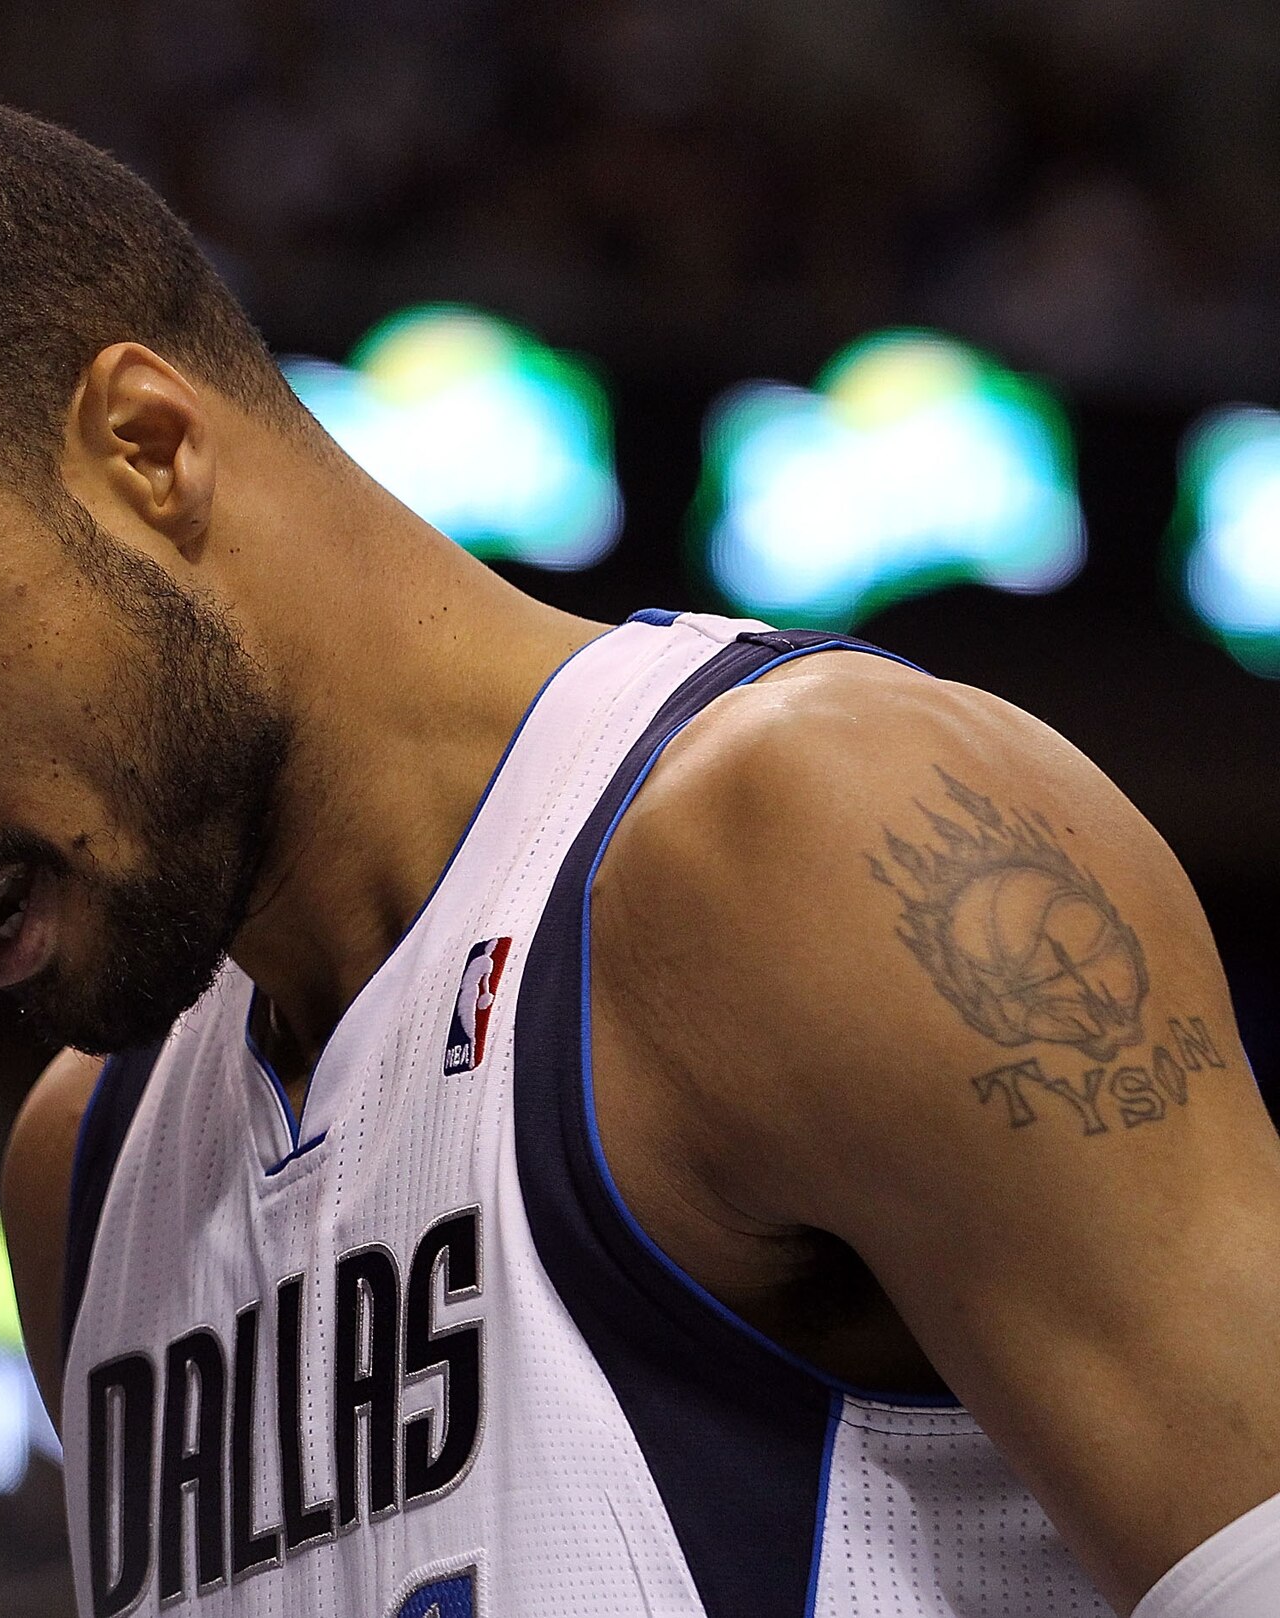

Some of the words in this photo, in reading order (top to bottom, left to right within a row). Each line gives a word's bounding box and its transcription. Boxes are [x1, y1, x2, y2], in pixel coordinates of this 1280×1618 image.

[445, 1044, 470, 1069] NBA
[972, 1016, 1226, 1136] TYSON
[87, 1203, 487, 1618] DALLAS
